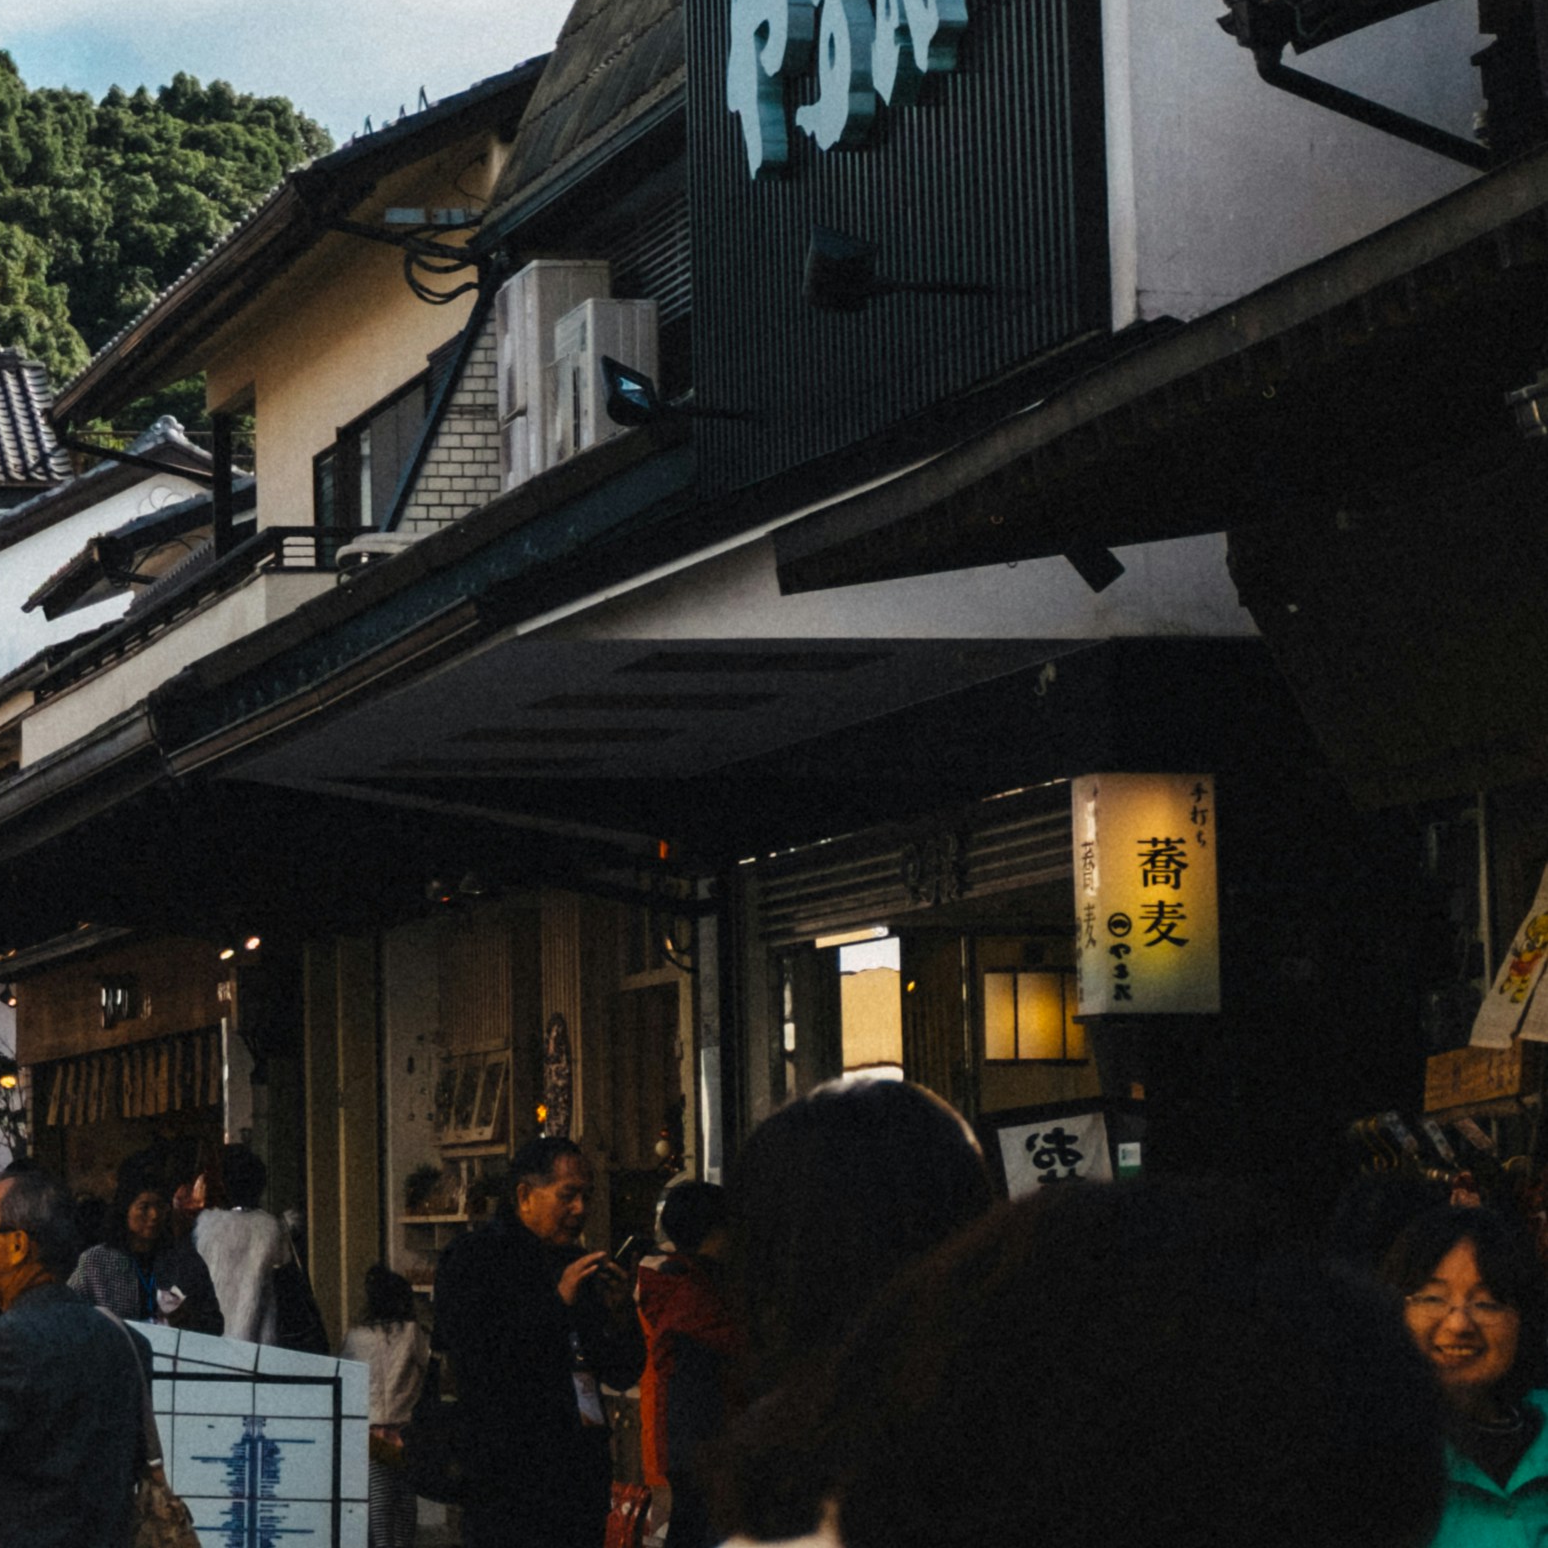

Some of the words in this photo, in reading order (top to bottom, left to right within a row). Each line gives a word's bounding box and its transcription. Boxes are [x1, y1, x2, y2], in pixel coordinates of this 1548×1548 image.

[1190, 782, 1210, 848] 手打ち
[1137, 836, 1190, 949] 蕎麦
